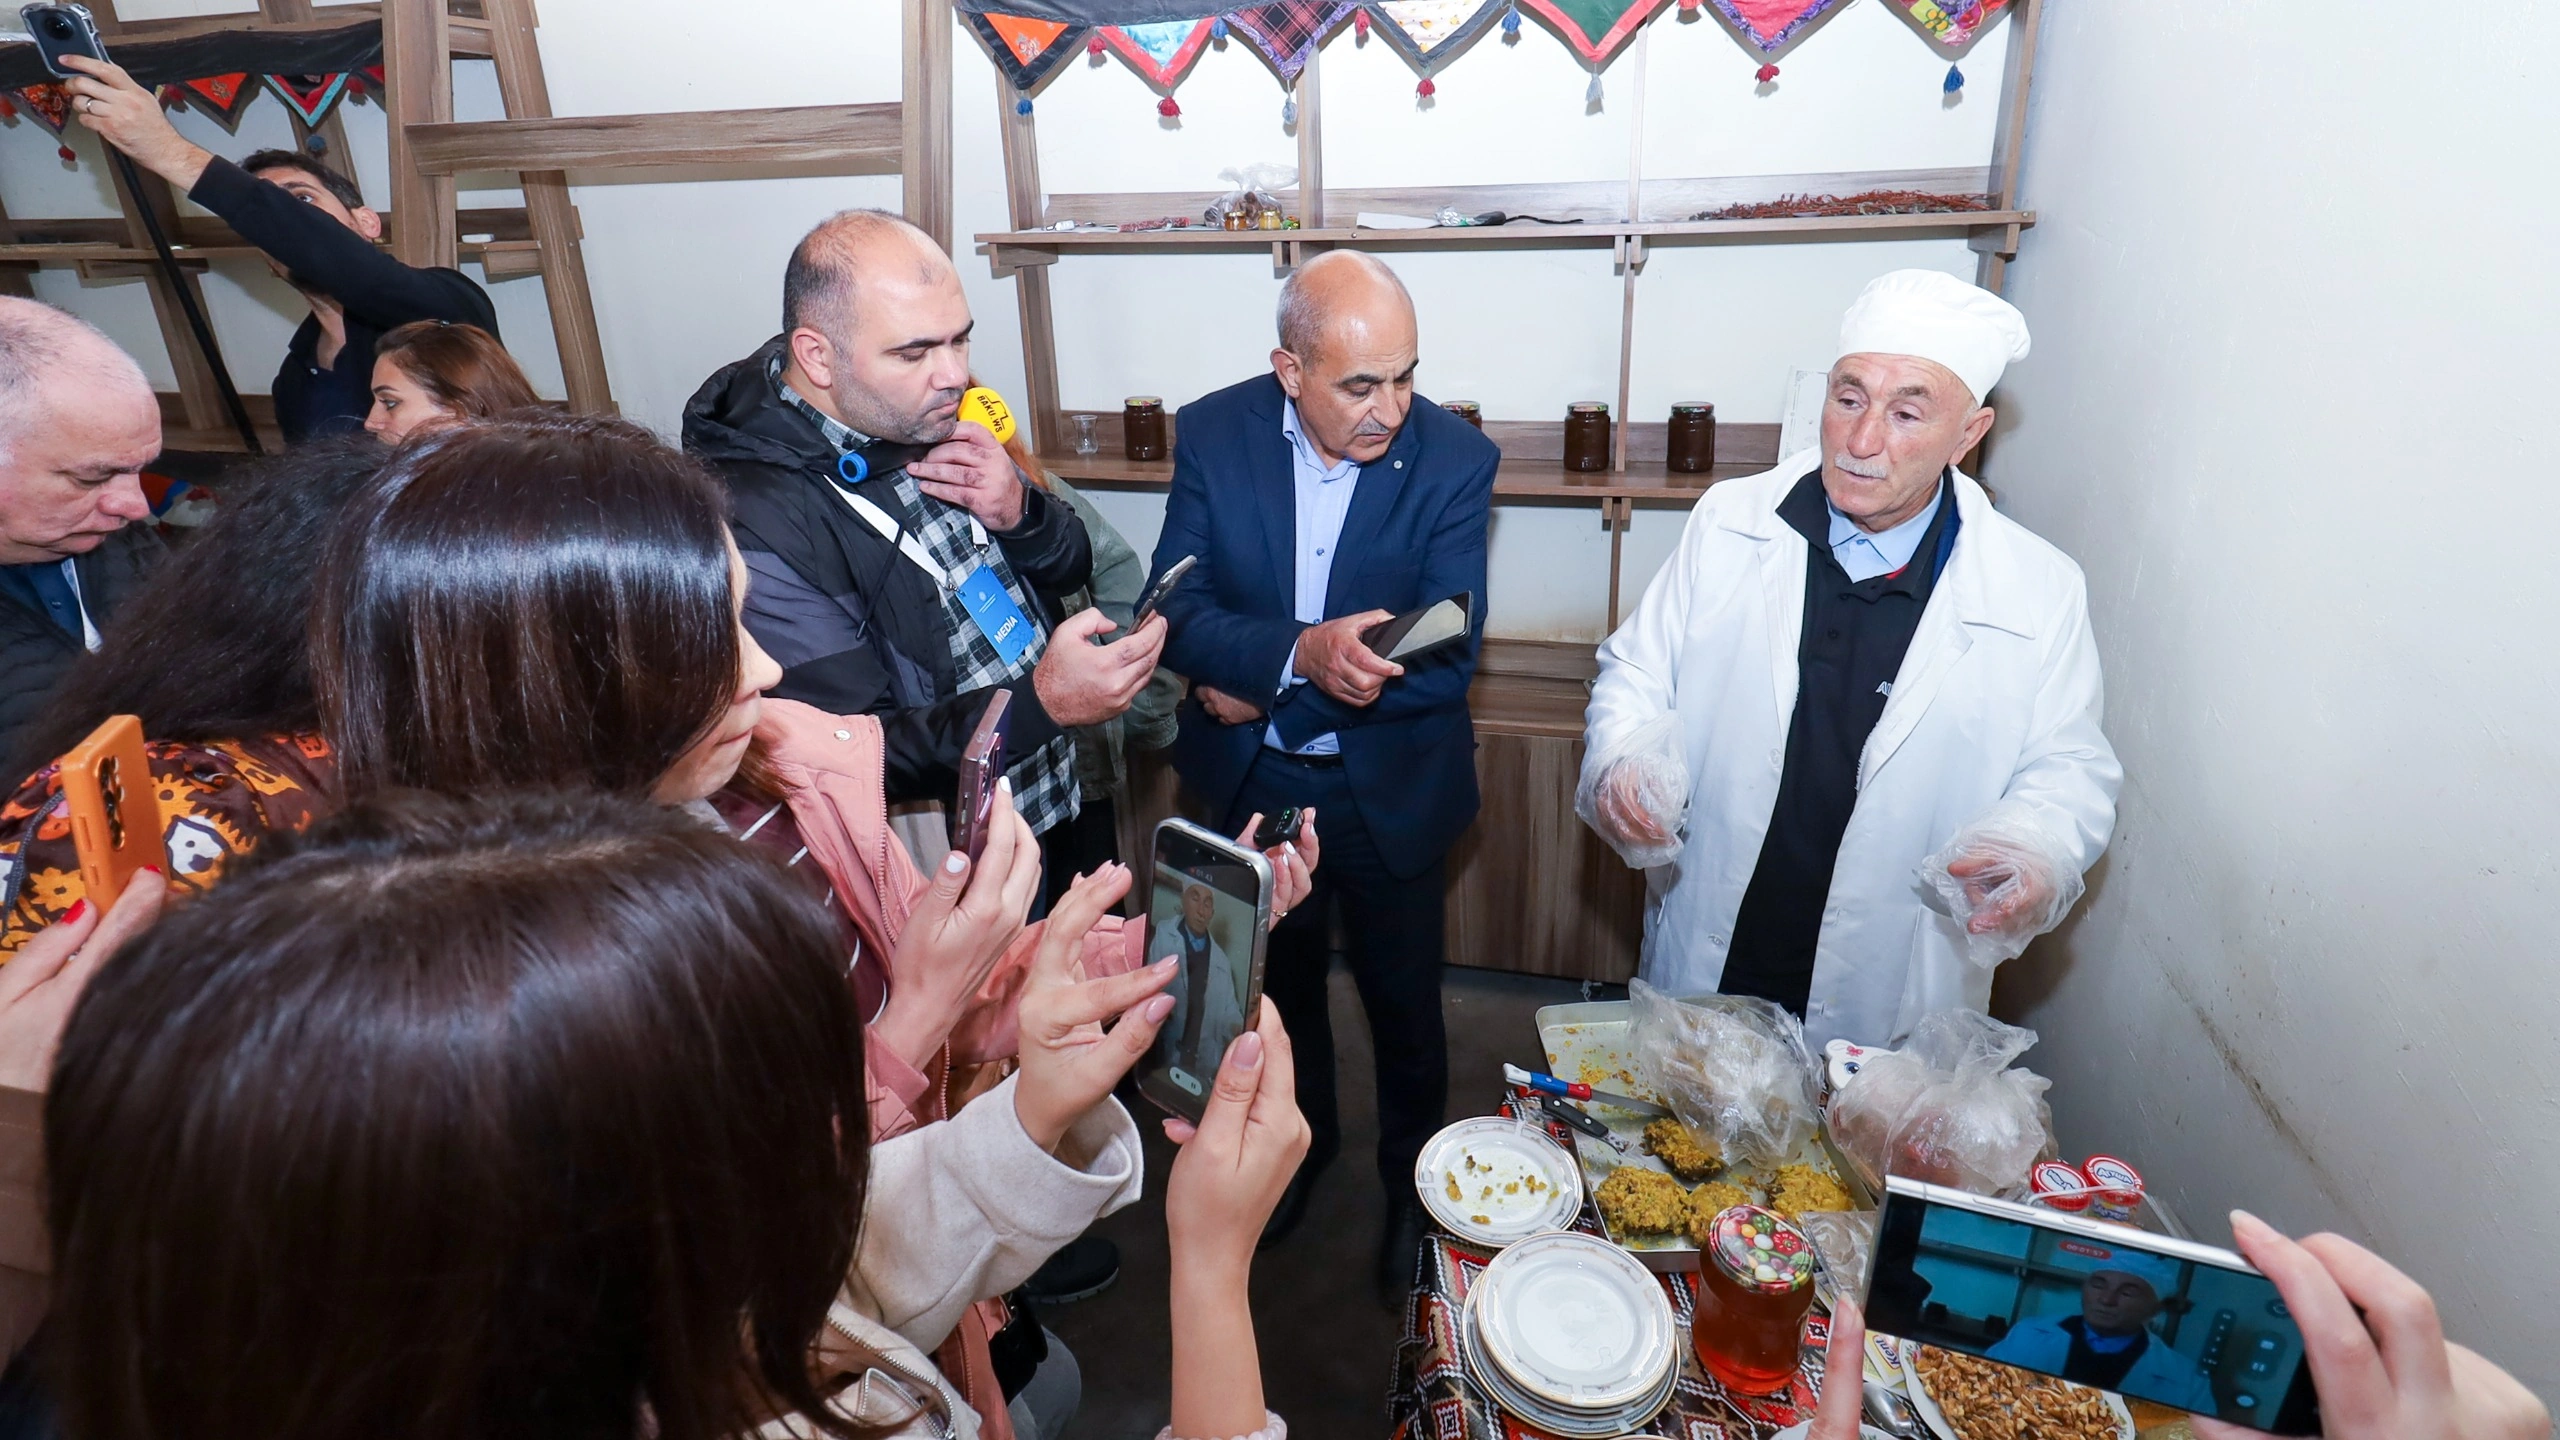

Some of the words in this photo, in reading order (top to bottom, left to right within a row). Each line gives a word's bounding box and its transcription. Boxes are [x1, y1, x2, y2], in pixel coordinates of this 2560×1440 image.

[977, 395, 1003, 433] BAKU.WS
[2066, 1243, 2105, 1257] 00:01:57
[1875, 1337, 1901, 1365] Kent
